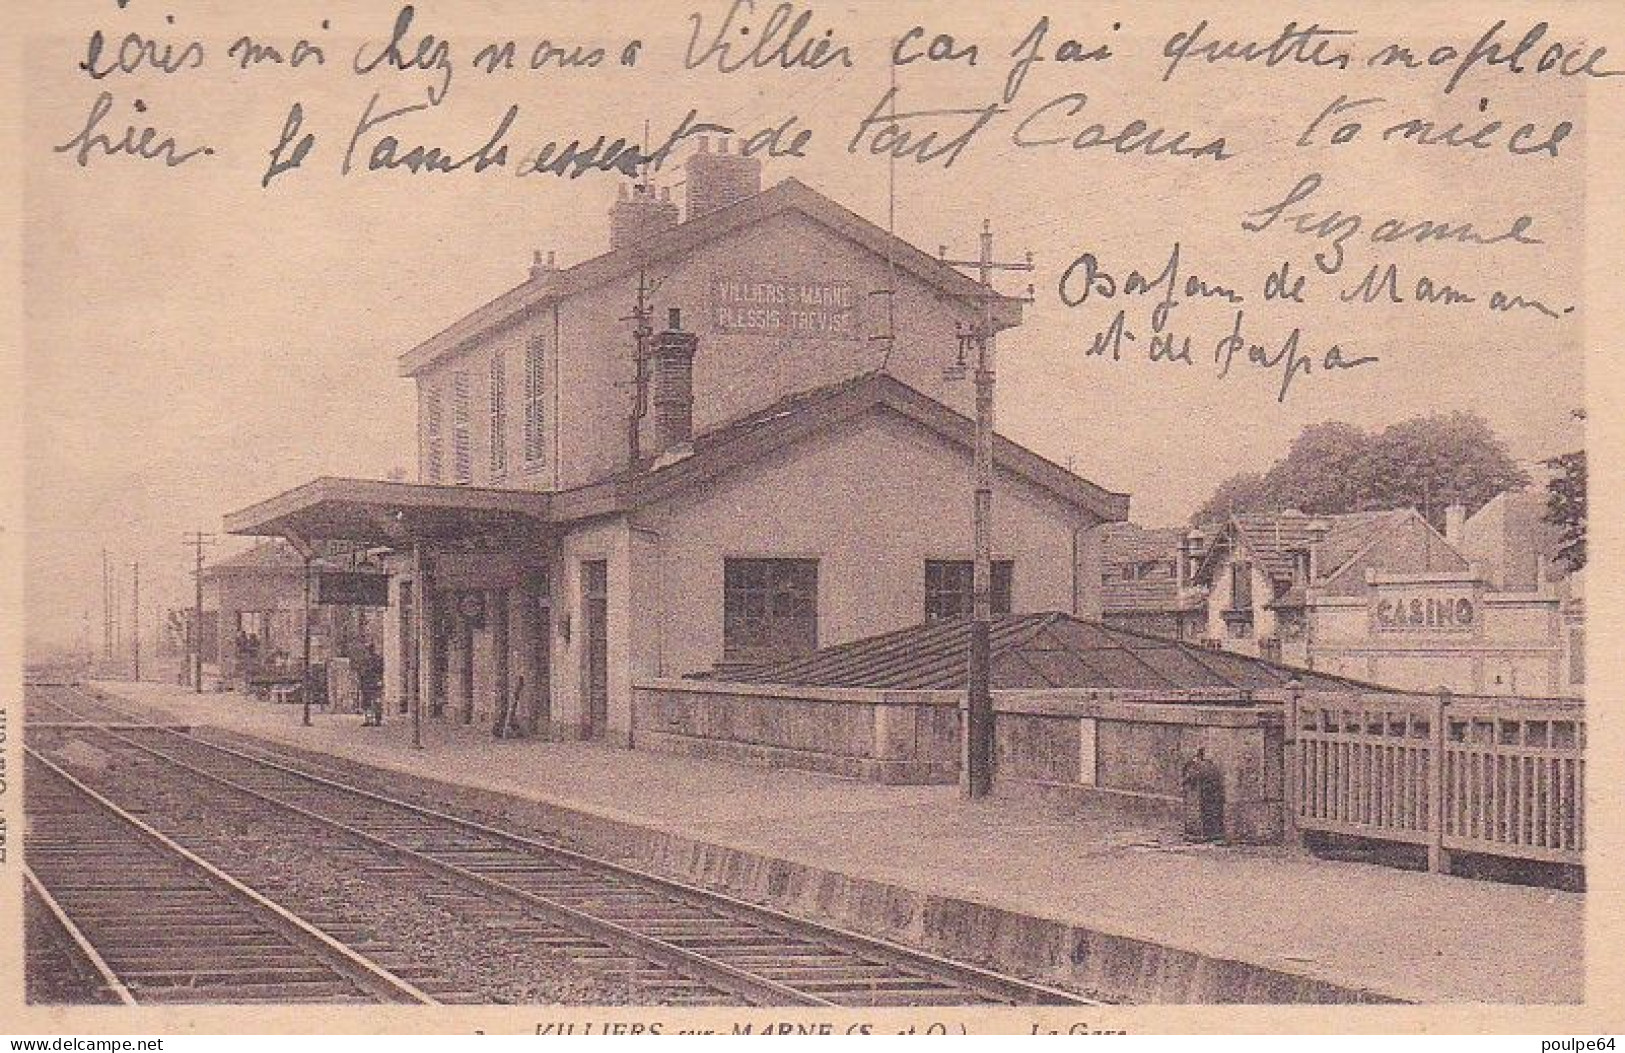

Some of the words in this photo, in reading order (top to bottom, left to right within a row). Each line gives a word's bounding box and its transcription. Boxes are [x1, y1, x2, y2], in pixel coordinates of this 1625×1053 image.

[228, 19, 326, 69] moi
[353, 5, 453, 106] chez
[739, 116, 813, 157] de
[1264, 262, 1306, 302] de
[1149, 330, 1194, 365] de
[1376, 597, 1475, 626] CASINO
